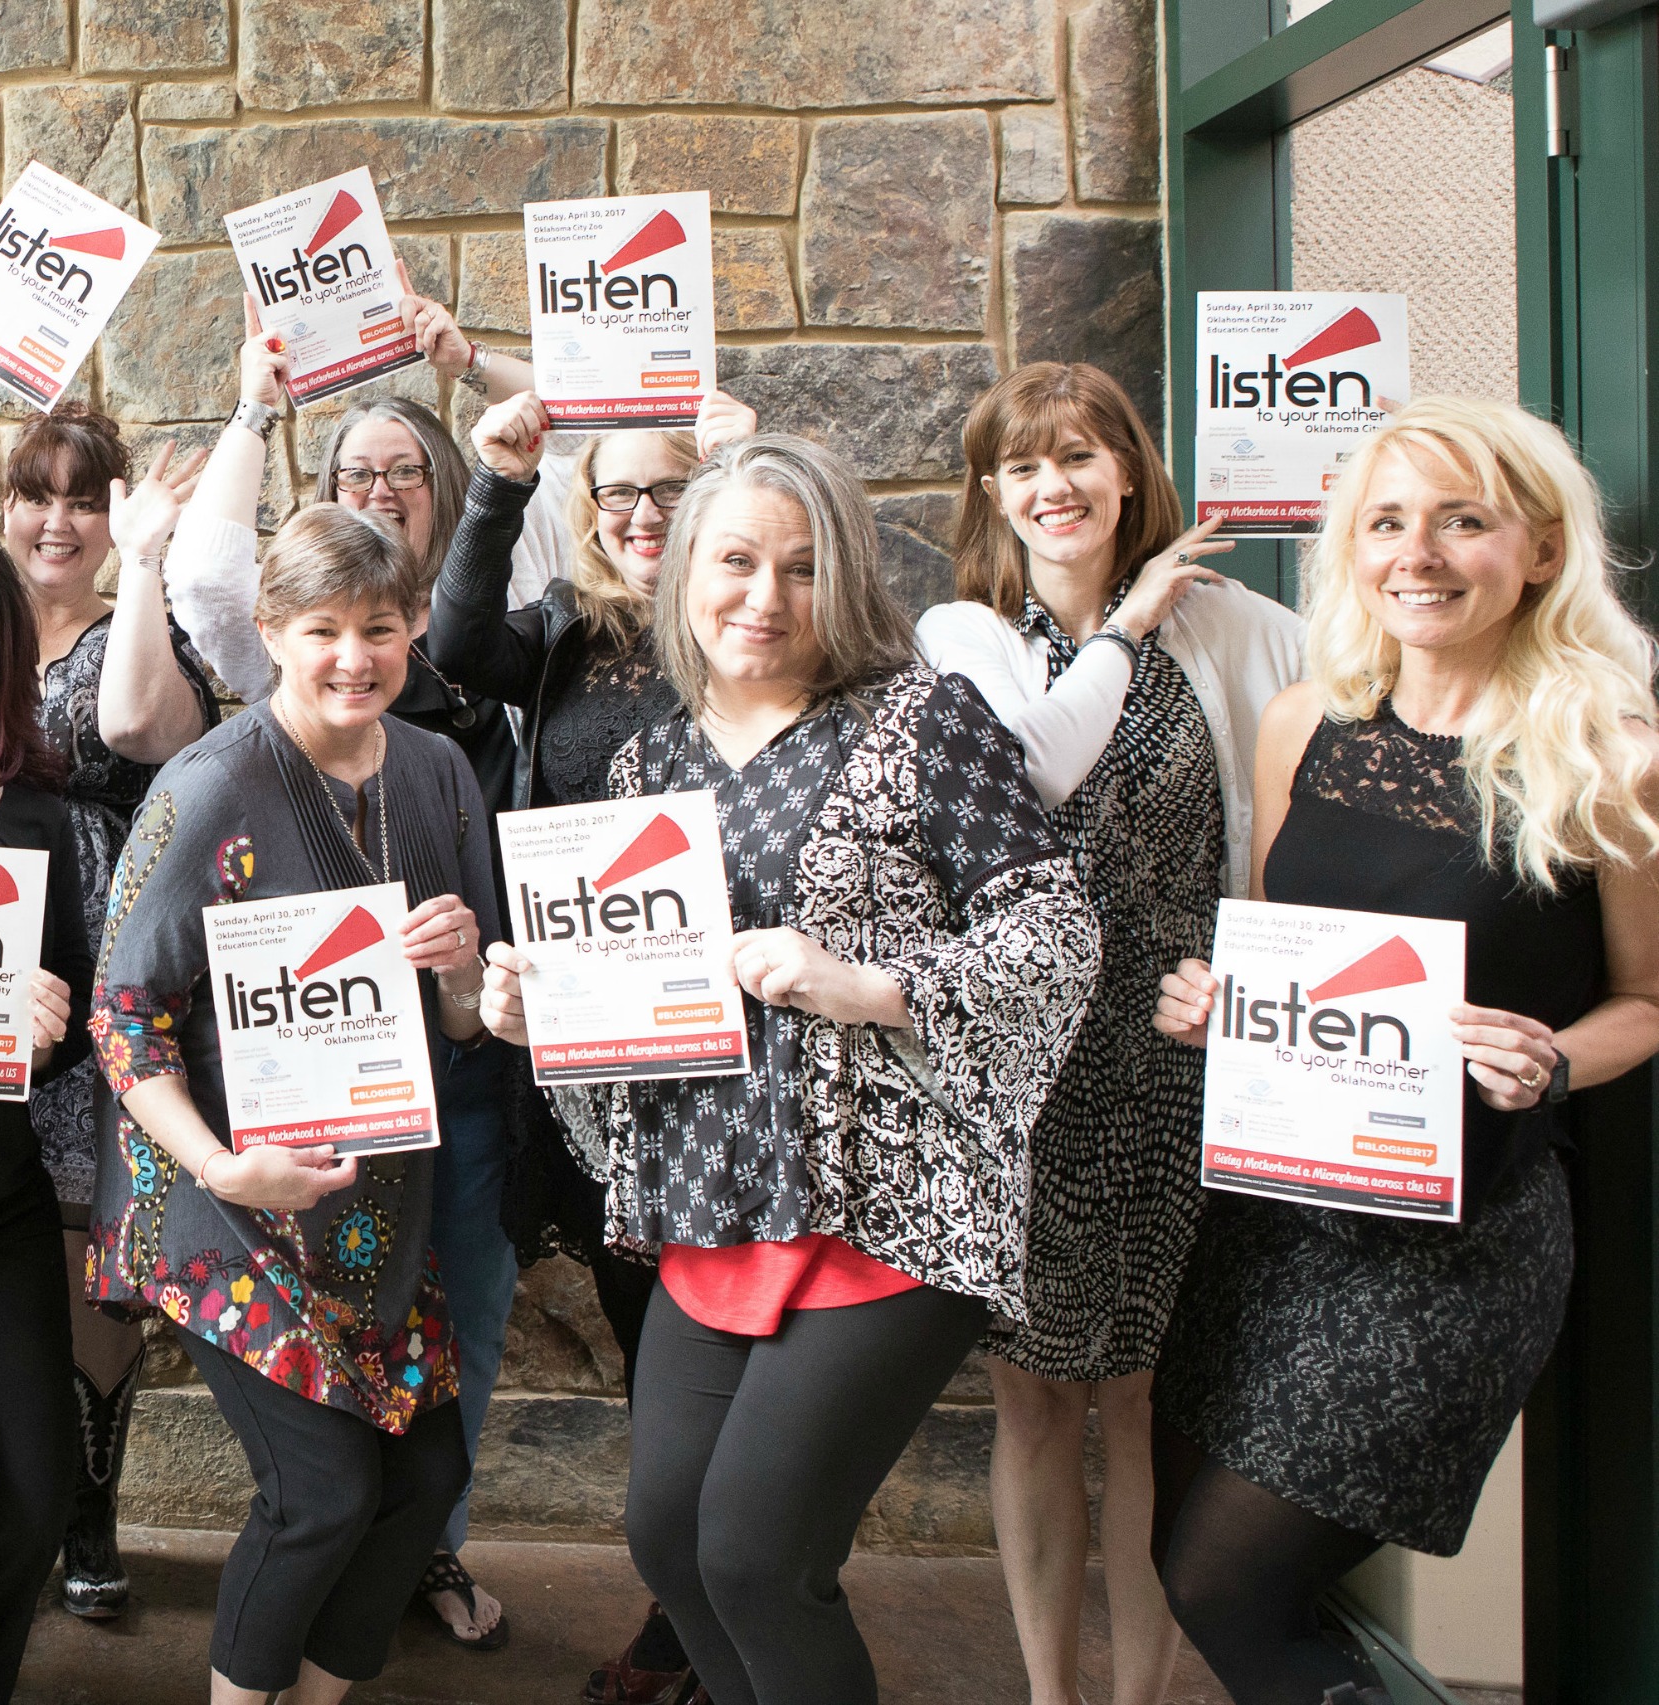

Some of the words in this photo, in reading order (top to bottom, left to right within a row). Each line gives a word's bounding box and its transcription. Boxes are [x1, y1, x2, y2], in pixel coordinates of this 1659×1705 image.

[251, 244, 373, 307] listen
[539, 259, 677, 314] listen
[7, 261, 19, 276] to
[20, 272, 48, 292] your
[48, 289, 89, 318] mother
[299, 294, 312, 306] to
[314, 284, 342, 304] your
[345, 269, 383, 290] mother
[335, 288, 372, 303] Oklahoma
[31, 293, 65, 317] Oklahoma
[65, 313, 80, 327] City
[580, 311, 596, 325] to
[599, 313, 633, 329] your
[638, 307, 692, 323] mother
[1247, 302, 1271, 312] April
[1290, 302, 1314, 310] 2017
[622, 325, 669, 334] Oklahoma
[670, 323, 689, 333] City
[1206, 326, 1249, 334] Education
[1250, 325, 1279, 333] Center
[1251, 315, 1269, 324] City
[1270, 315, 1288, 323] Zoo
[643, 374, 698, 384] #BLOGHER17
[1209, 353, 1369, 408] listen
[1256, 407, 1274, 421] to
[1278, 411, 1318, 426] your
[1324, 406, 1386, 421] mother
[1304, 424, 1359, 432] Oklahoma
[519, 876, 688, 943] listen
[574, 938, 592, 954] to
[596, 937, 637, 957] your
[642, 928, 706, 948] mother
[625, 951, 680, 962] Oklahoma
[682, 947, 704, 958] City
[224, 965, 382, 1030] listen
[276, 1024, 293, 1039] to
[297, 1022, 335, 1042] your
[340, 1012, 398, 1032] mother
[1221, 974, 1409, 1060] listen
[323, 1034, 375, 1046] Oklahoma
[376, 1030, 397, 1040] City
[1274, 1044, 1294, 1062] to
[1300, 1053, 1347, 1076] your
[1354, 1058, 1428, 1079] mother
[5, 1067, 19, 1079] US
[1331, 1072, 1395, 1089] Oklahoma
[1398, 1080, 1423, 1095] City
[1356, 1140, 1431, 1158] #BLOGHER17
